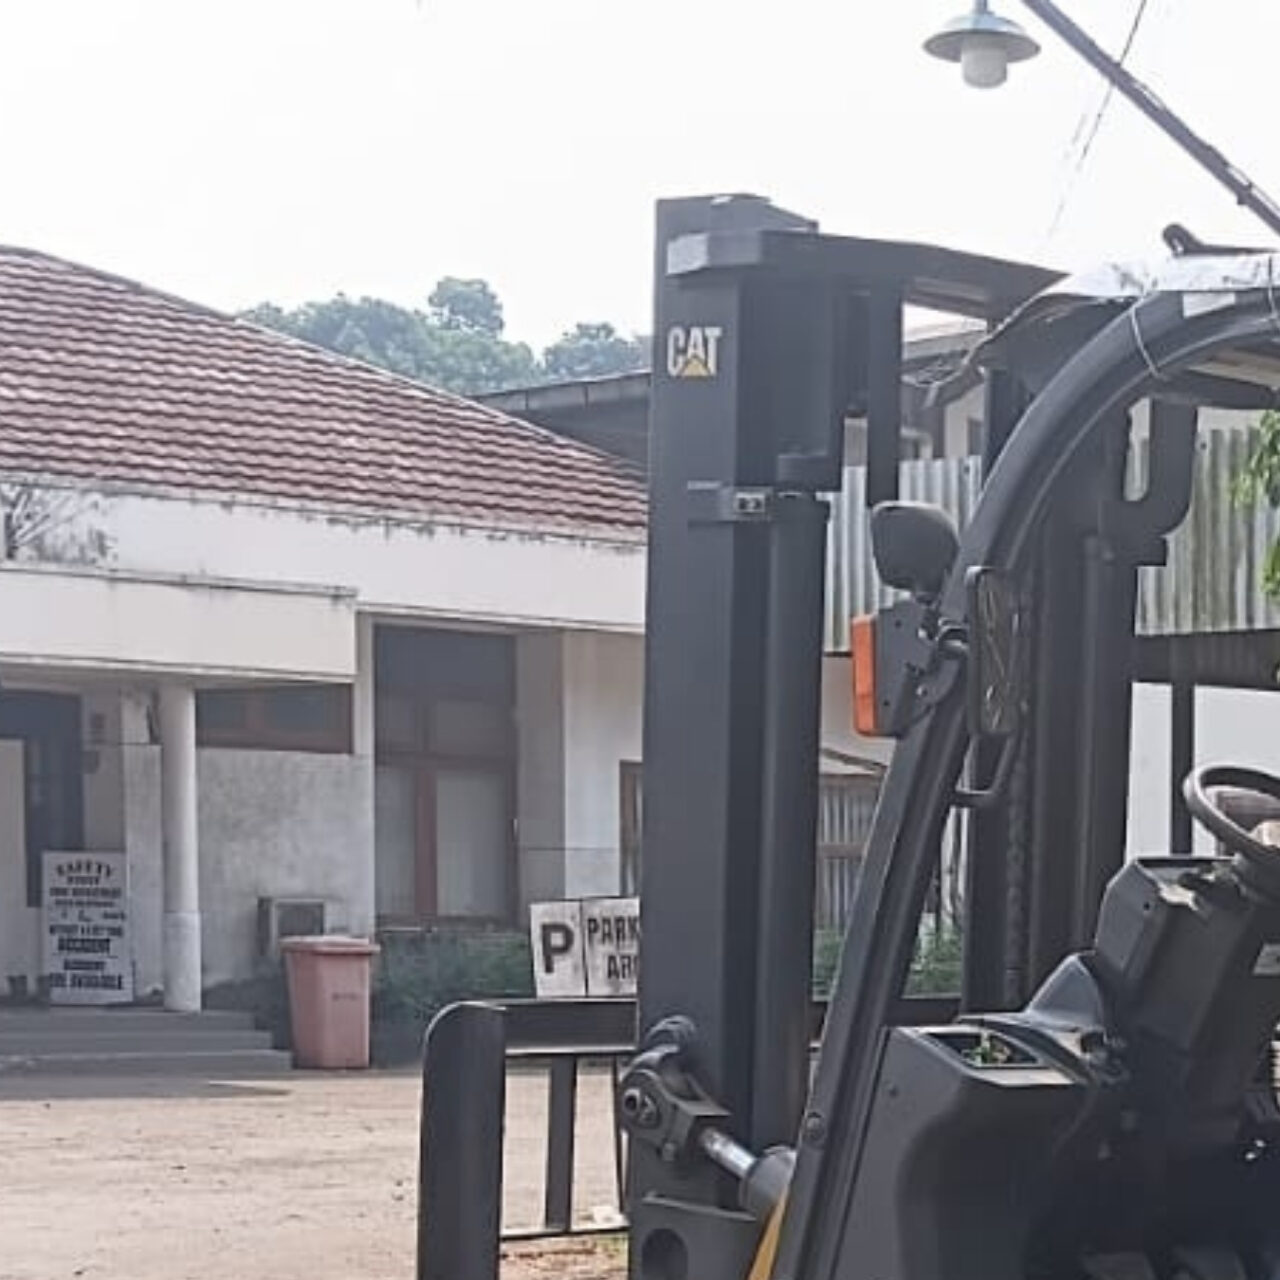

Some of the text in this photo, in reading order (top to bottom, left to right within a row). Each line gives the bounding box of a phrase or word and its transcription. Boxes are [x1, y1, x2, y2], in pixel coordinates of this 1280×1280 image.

[667, 327, 722, 376] CAT
[541, 923, 575, 974] P
[607, 954, 638, 979] AR
